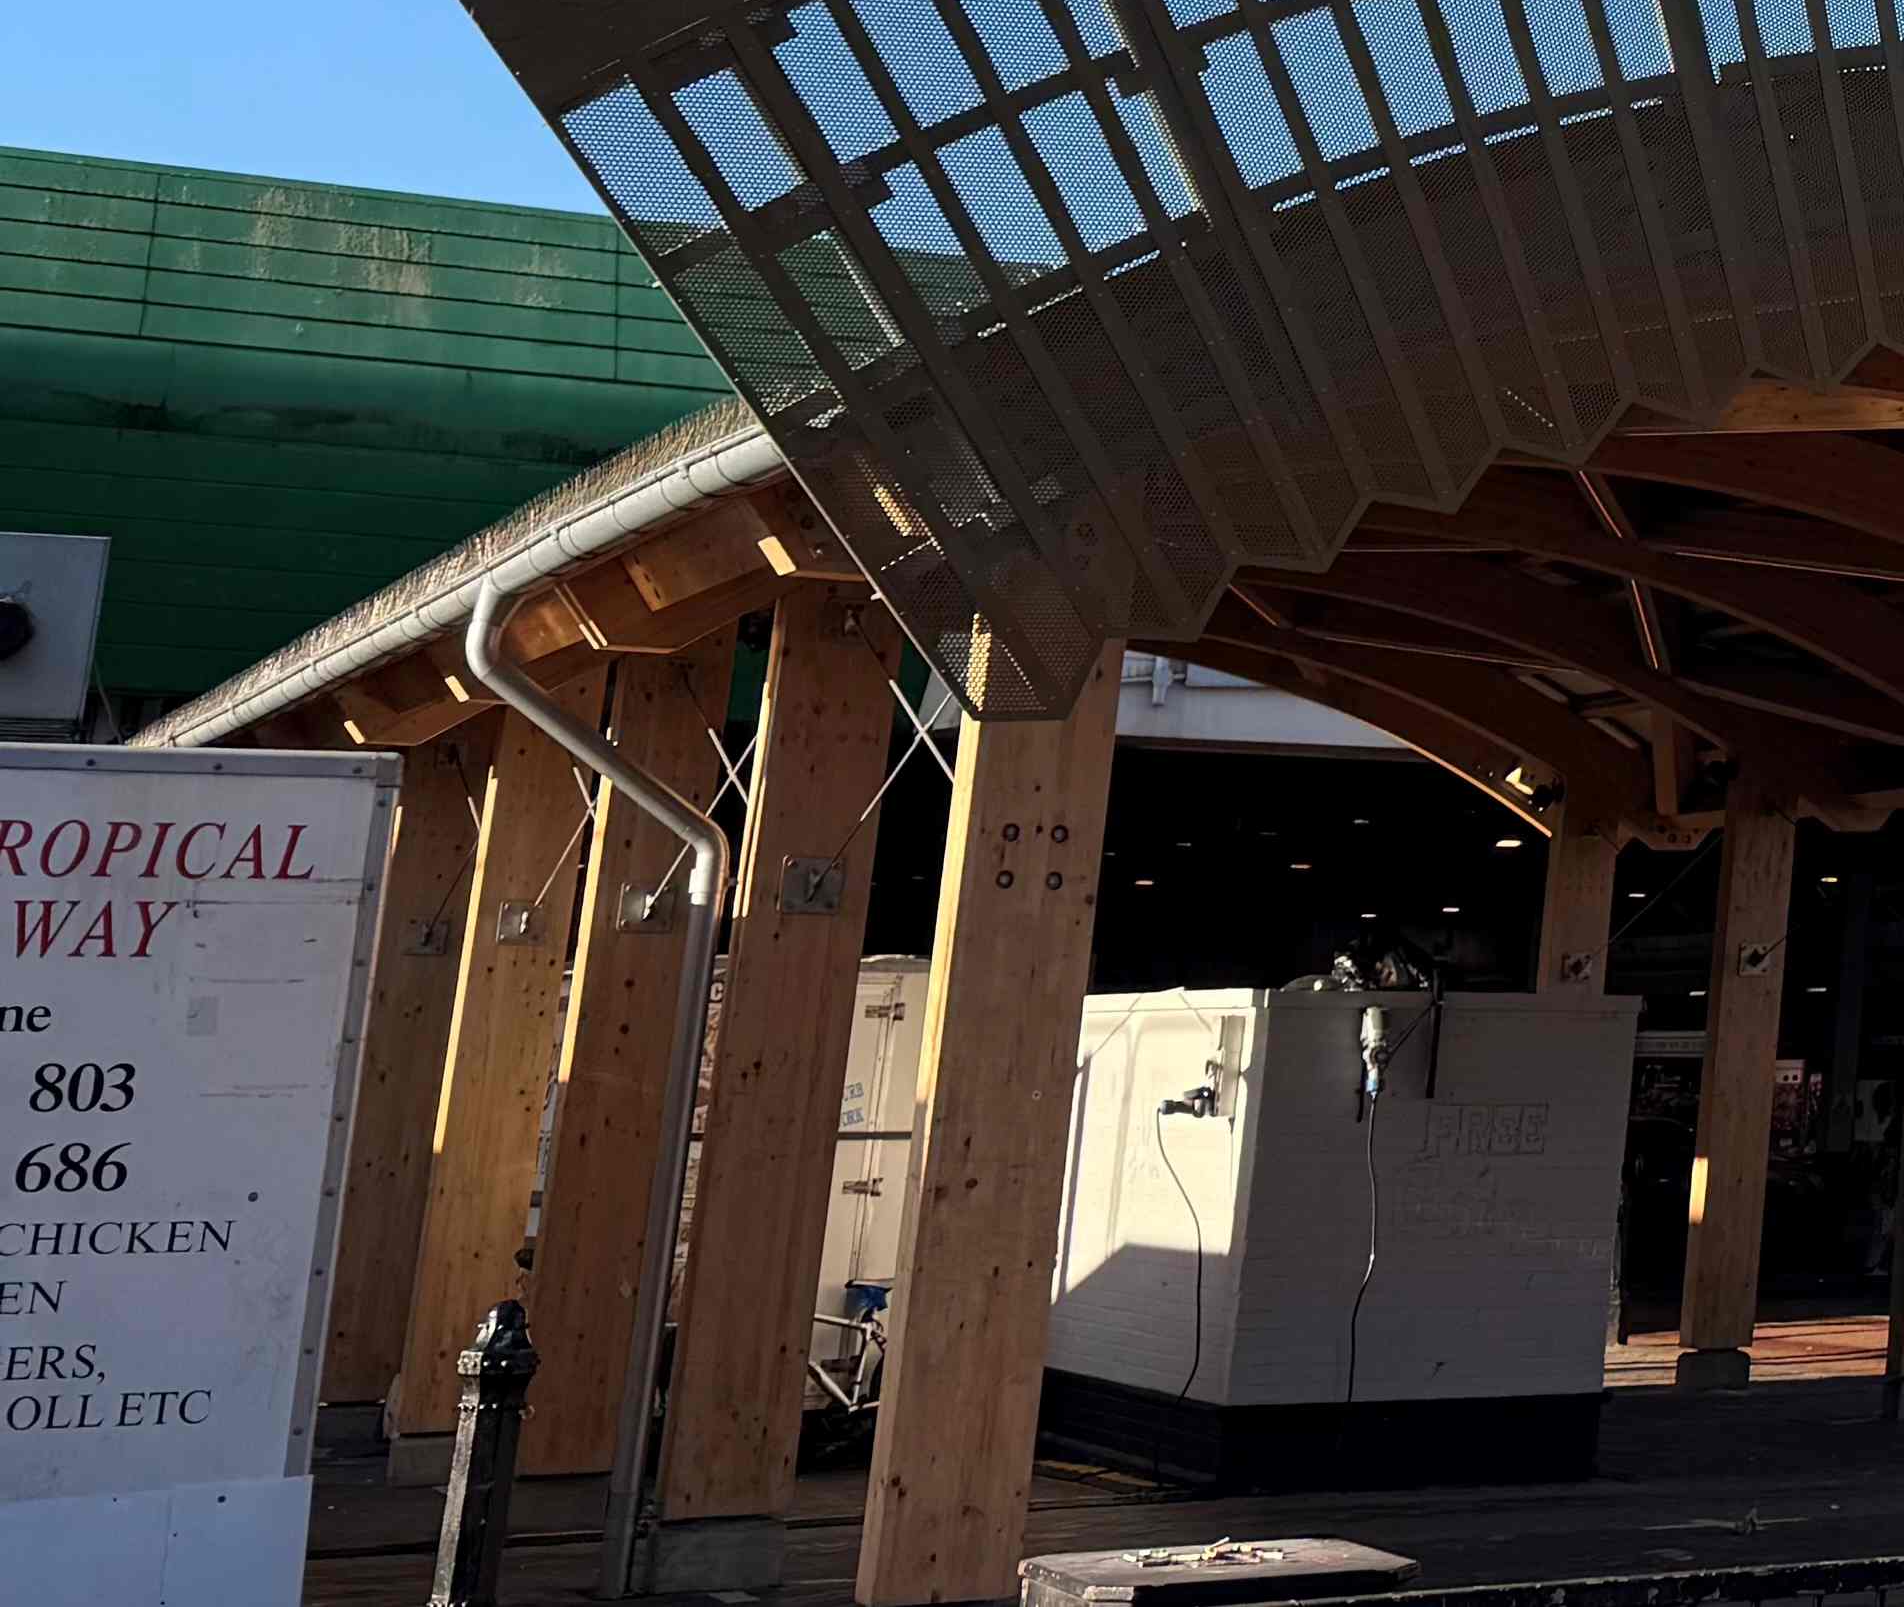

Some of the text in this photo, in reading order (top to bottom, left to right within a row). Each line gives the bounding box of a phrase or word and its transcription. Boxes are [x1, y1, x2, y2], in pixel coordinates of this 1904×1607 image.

[13, 899, 181, 958] WAY
[29, 1062, 136, 1112] 803
[15, 1142, 132, 1192] 686
[0, 1220, 237, 1257] CHICKEN
[115, 1389, 212, 1427] ETC
